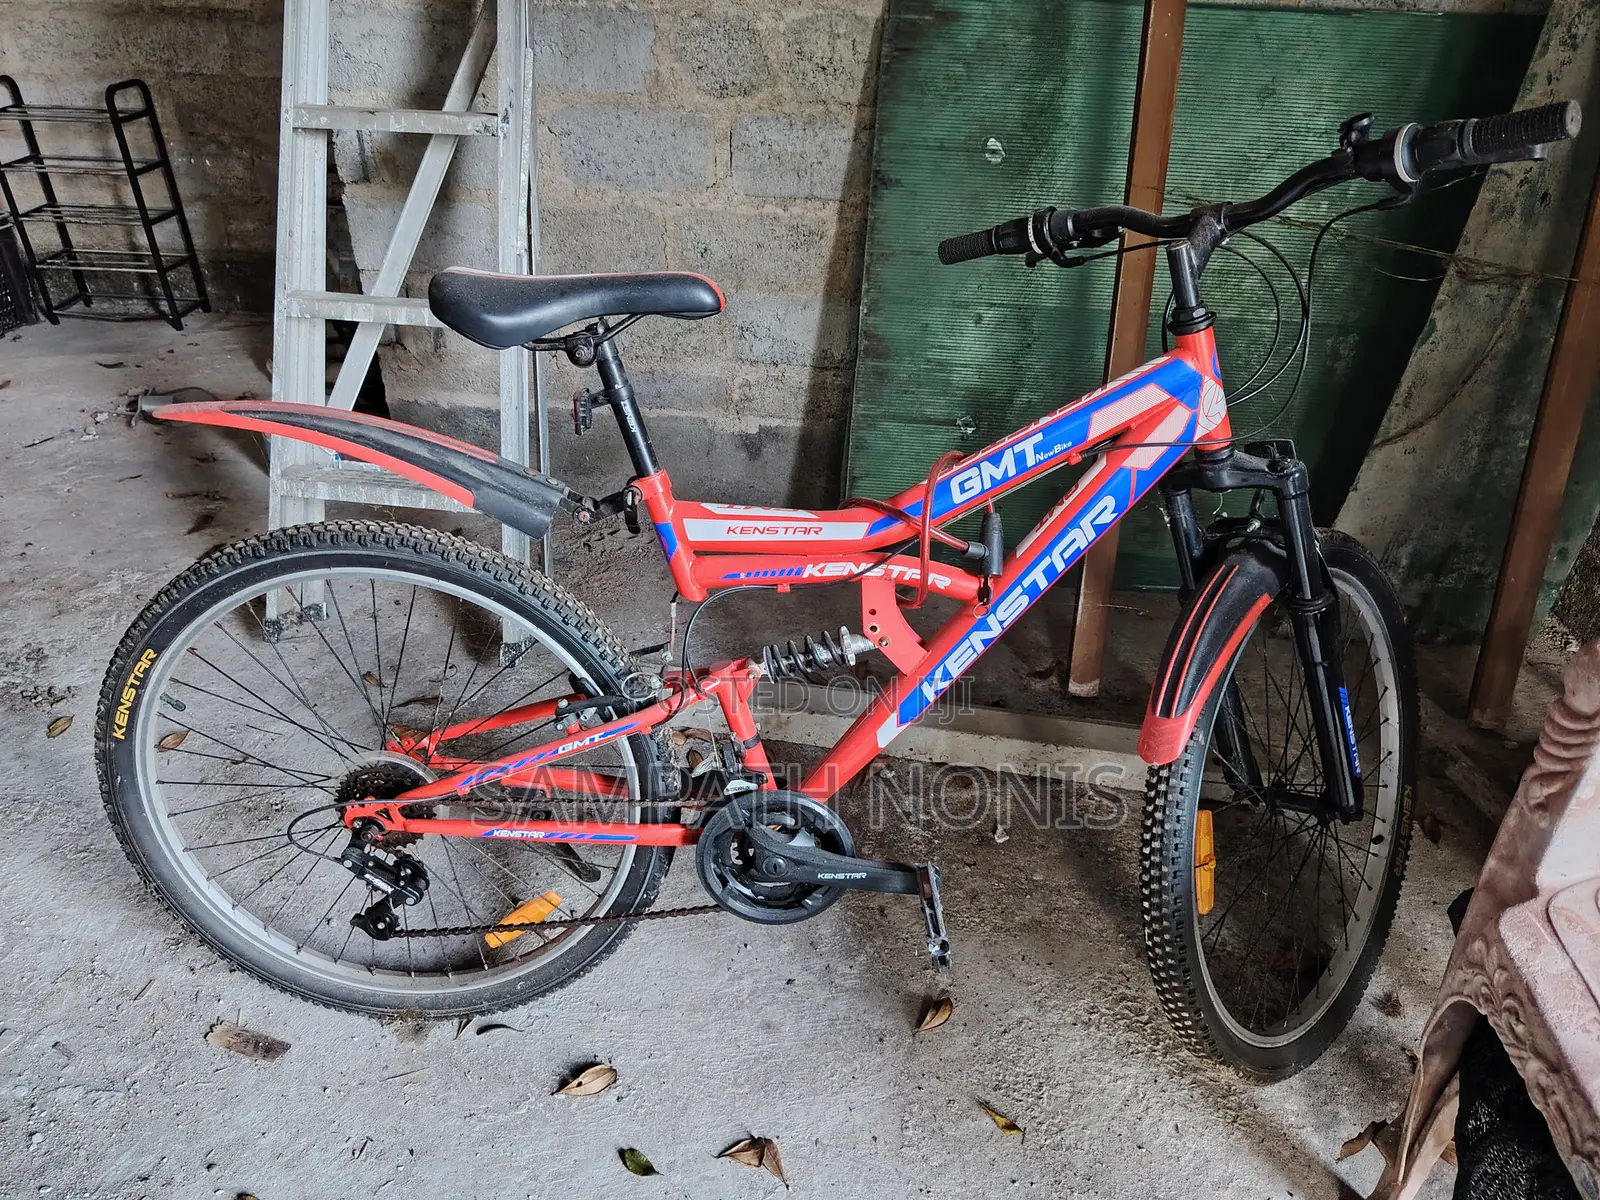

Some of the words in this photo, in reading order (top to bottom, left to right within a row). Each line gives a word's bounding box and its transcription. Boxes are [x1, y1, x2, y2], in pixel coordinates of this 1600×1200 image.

[949, 431, 1043, 505] GMT
[726, 525, 823, 536] KENSTAR
[801, 561, 952, 590] KENSTAR
[920, 494, 1119, 704] KENSTAR
[112, 648, 158, 740] KENSTAR
[558, 731, 606, 755] GMT
[492, 829, 546, 839] KENSTAR
[817, 872, 868, 880] KENSTAR
